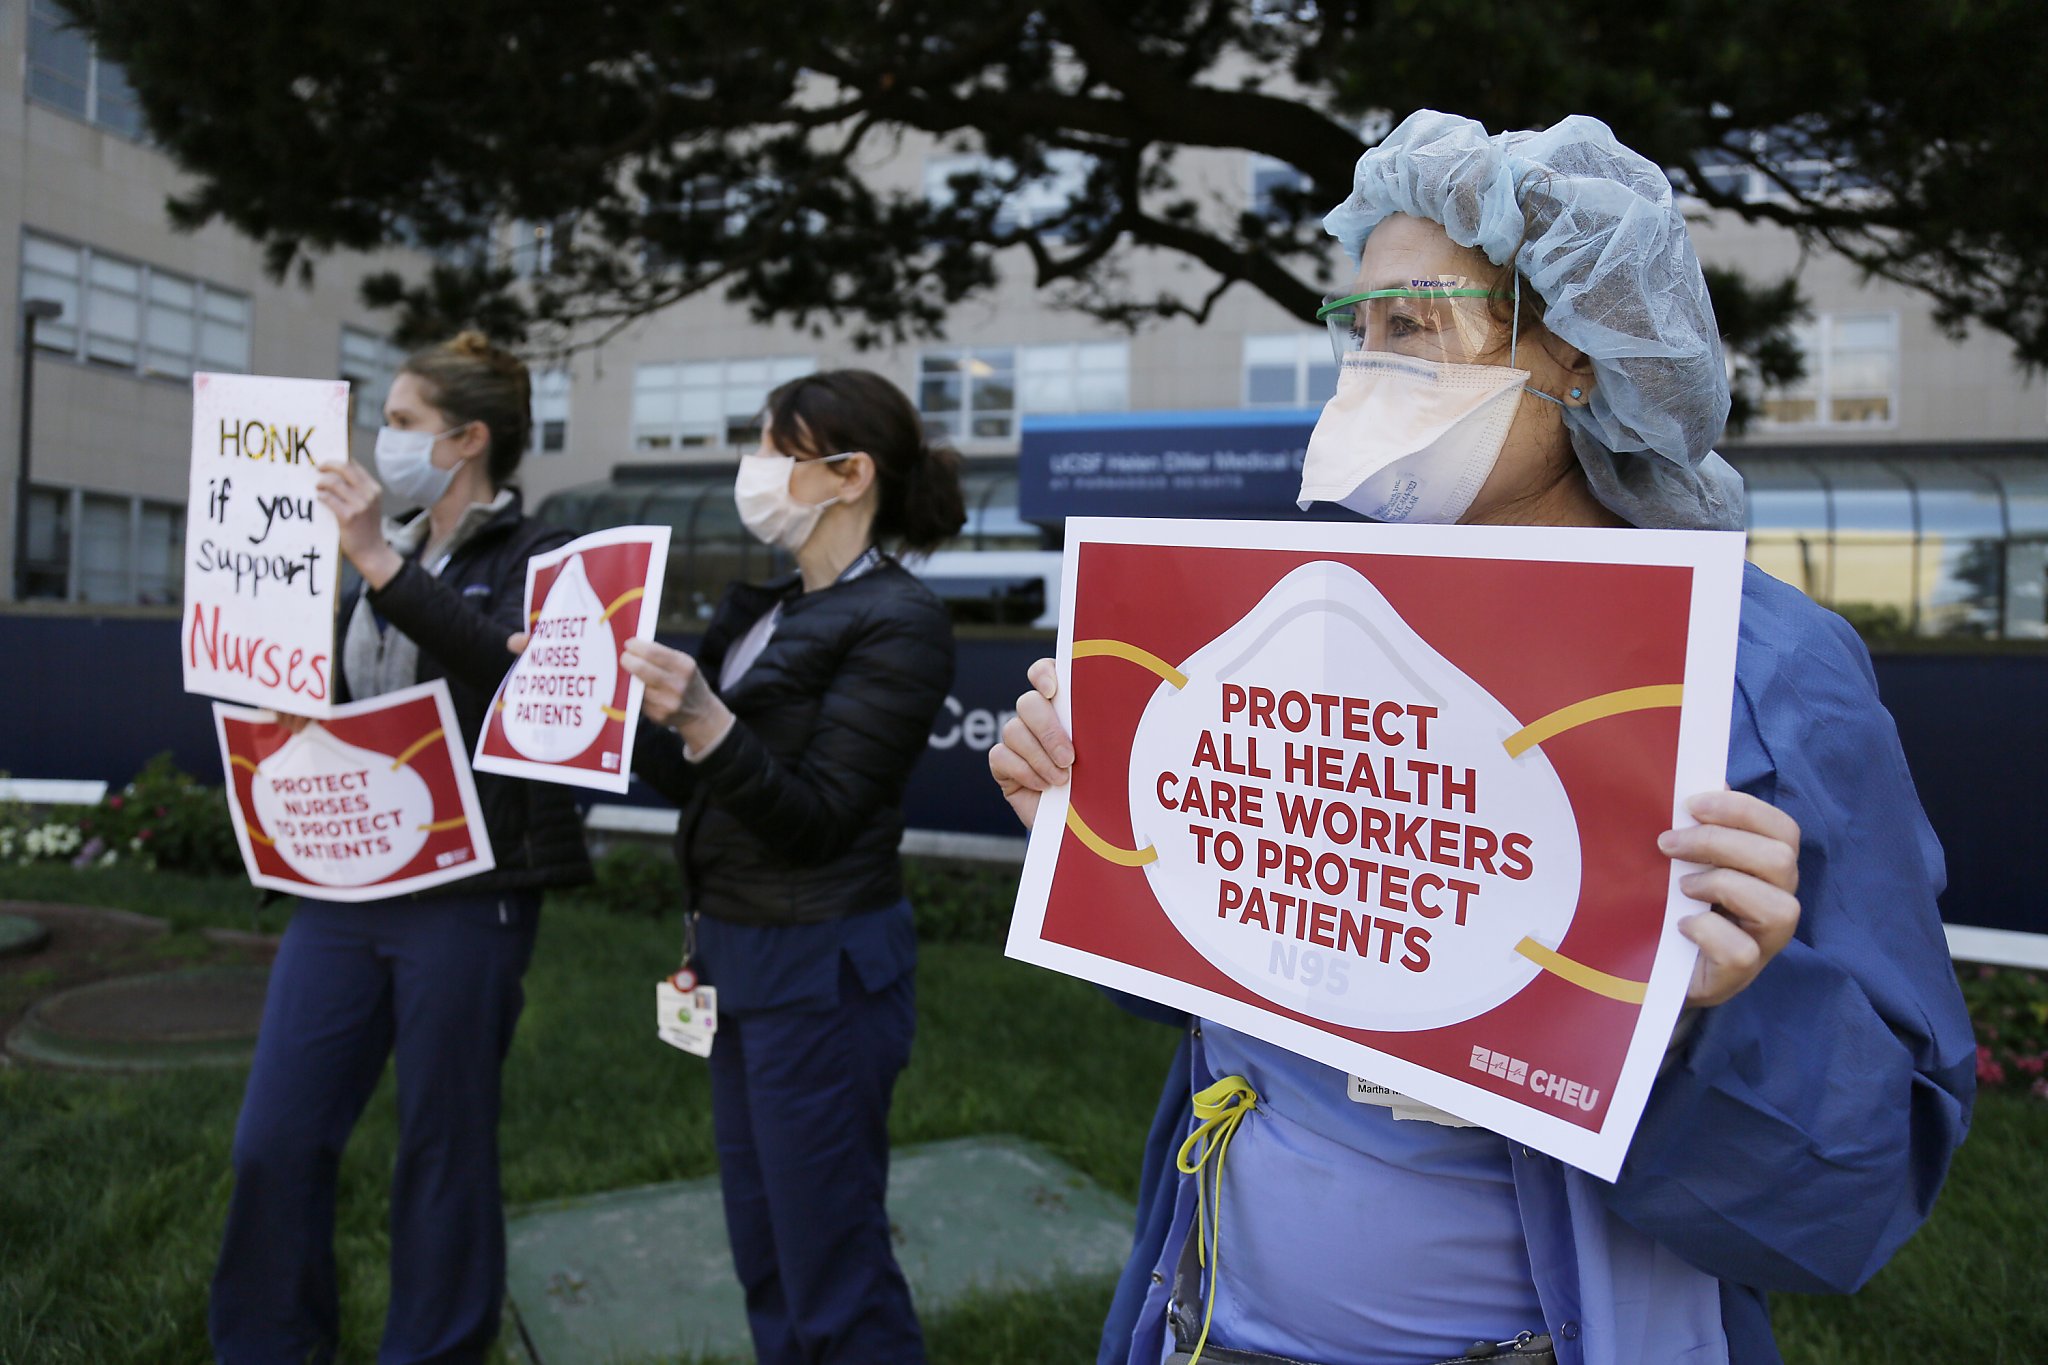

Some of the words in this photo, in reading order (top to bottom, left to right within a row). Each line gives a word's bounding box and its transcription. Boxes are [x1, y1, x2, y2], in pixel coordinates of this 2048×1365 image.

[220, 418, 316, 465] HONK
[1049, 453, 1102, 474] UCSF
[1106, 454, 1160, 472] Helen
[1214, 451, 1287, 471] Medical
[208, 478, 231, 523] if
[248, 496, 313, 544] you
[532, 616, 588, 639] PROTECT
[190, 602, 327, 700] Nurses
[530, 646, 580, 668] NURSES
[515, 675, 528, 695] TO
[529, 676, 597, 697] PROTECT
[515, 704, 583, 727] PATIENTS
[1222, 683, 1439, 751] PROTECT
[271, 770, 371, 793] PROTECT
[1191, 730, 1271, 779] ALL
[1284, 741, 1477, 814] HEALTH
[283, 794, 370, 816] NURSES
[276, 821, 296, 838] TO
[300, 809, 404, 837] PROTECT
[1156, 771, 1264, 828] CARE
[1275, 791, 1535, 881] WORKERS
[292, 836, 393, 861] PATIENTS
[1189, 824, 1245, 872] TO
[1256, 838, 1481, 927] PROTECT
[1217, 878, 1433, 973] PATIENTS
[1268, 940, 1351, 996] N95
[1358, 1084, 1390, 1095] Martha
[1529, 1069, 1600, 1112] CHEU
